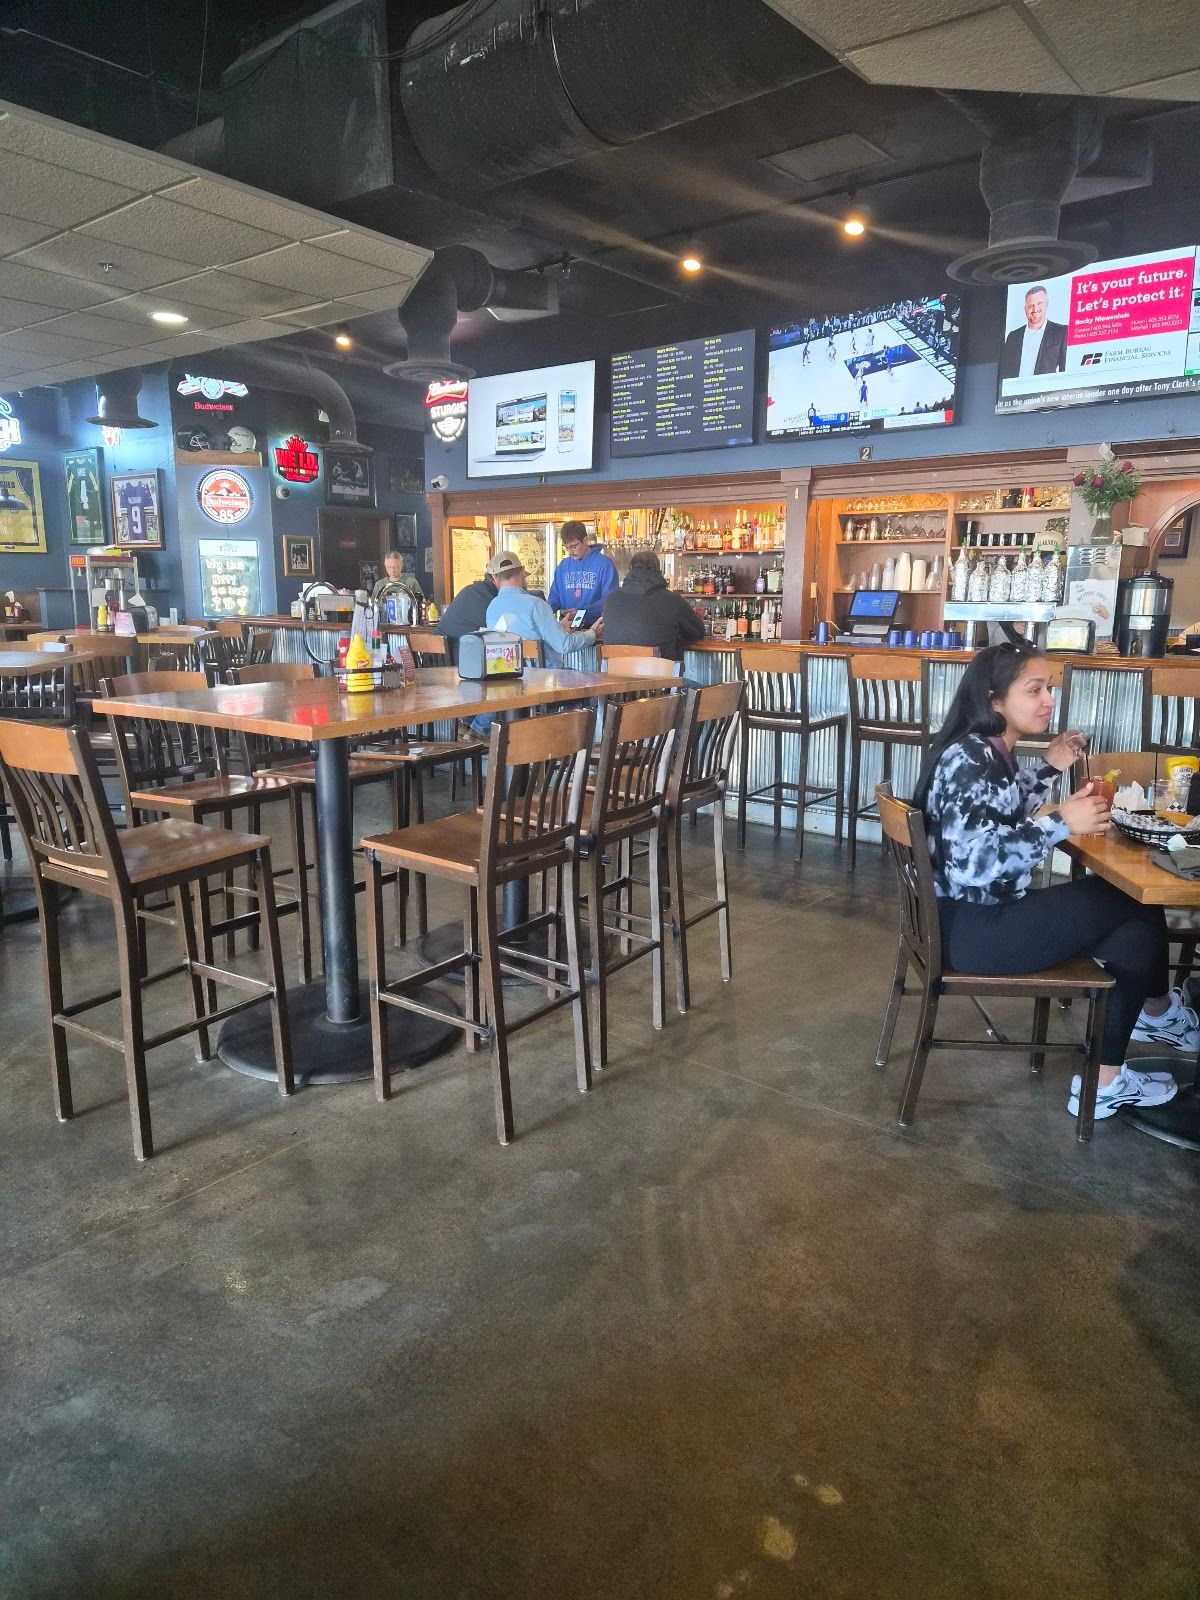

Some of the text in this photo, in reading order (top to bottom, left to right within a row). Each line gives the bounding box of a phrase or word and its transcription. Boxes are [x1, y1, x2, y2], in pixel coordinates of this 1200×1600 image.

[1076, 268, 1187, 295] It's your future.
[1076, 297, 1109, 313] Let's
[1112, 292, 1165, 310] protect
[1075, 317, 1093, 326] Rocky
[1104, 354, 1139, 364] FINANCIAL
[1105, 346, 1152, 358] FARM BUREAU
[1012, 398, 1023, 407] the
[1023, 394, 1045, 405] union's
[1084, 388, 1106, 398] leader
[1107, 388, 1120, 396] one
[1121, 386, 1134, 396] day
[1135, 383, 1153, 393] after
[1153, 382, 1171, 392] Tony
[1172, 377, 1196, 389] Clark's
[193, 401, 234, 412] Budweiser
[275, 448, 294, 467] WE
[861, 447, 870, 460] 2
[131, 505, 142, 534] 9
